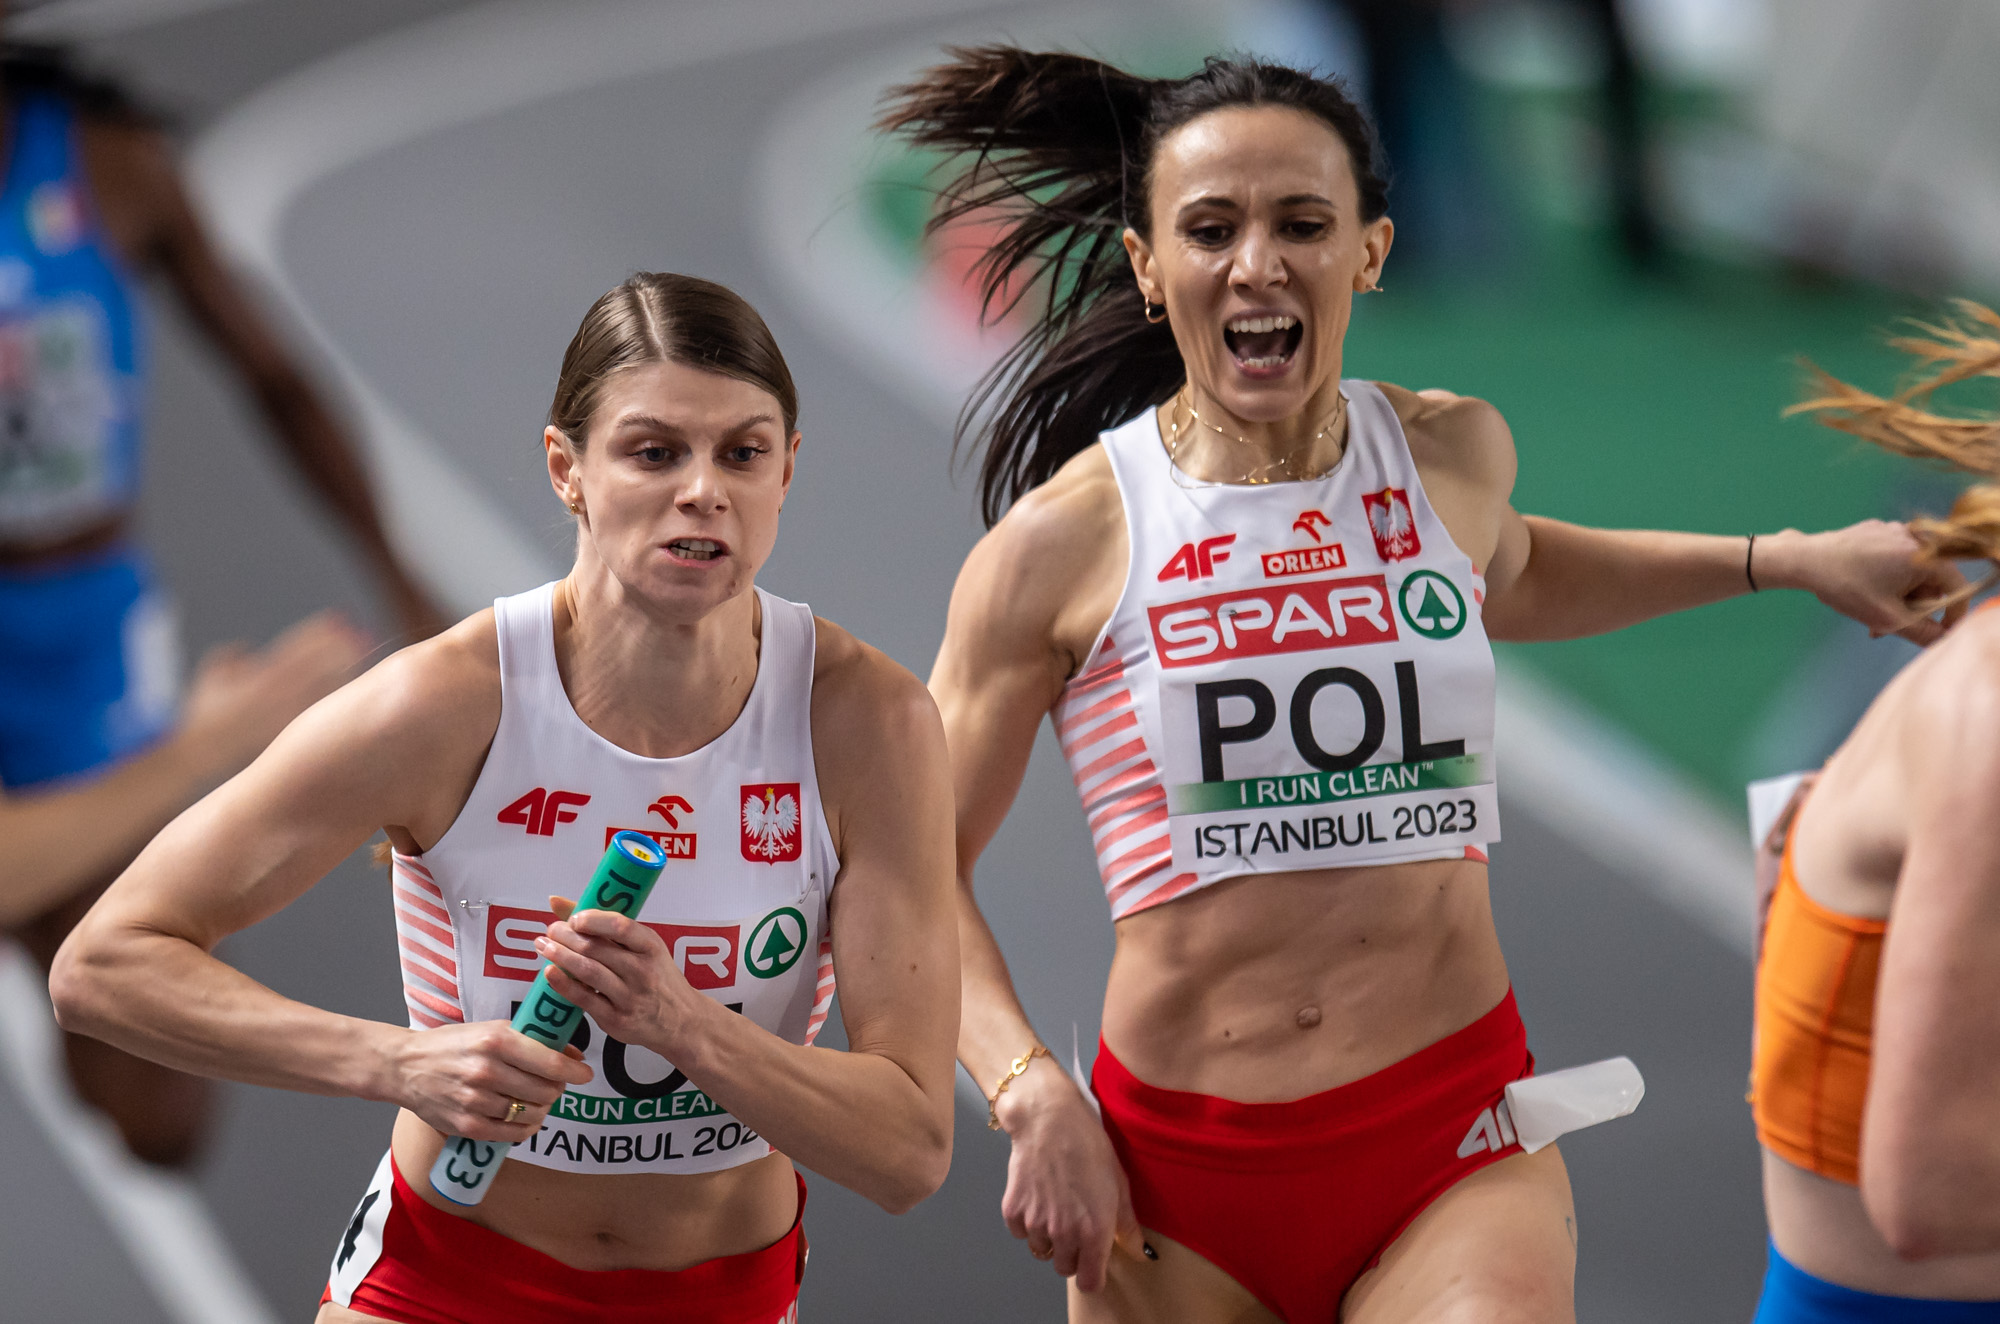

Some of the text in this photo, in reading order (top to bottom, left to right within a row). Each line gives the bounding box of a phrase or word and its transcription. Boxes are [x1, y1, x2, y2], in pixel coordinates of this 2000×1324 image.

[1157, 533, 1238, 583] 4F
[1266, 548, 1341, 576] ORLEN
[1158, 584, 1390, 660] SPAR
[1194, 661, 1466, 784] POL
[496, 787, 592, 836] 4F
[1240, 783, 1248, 805] I
[1257, 775, 1321, 804] RUN
[1195, 799, 1478, 859] ISTANBUL 2023
[493, 917, 732, 979] SR
[559, 1094, 624, 1121] RUN
[512, 1122, 760, 1164] TANBUL 202
